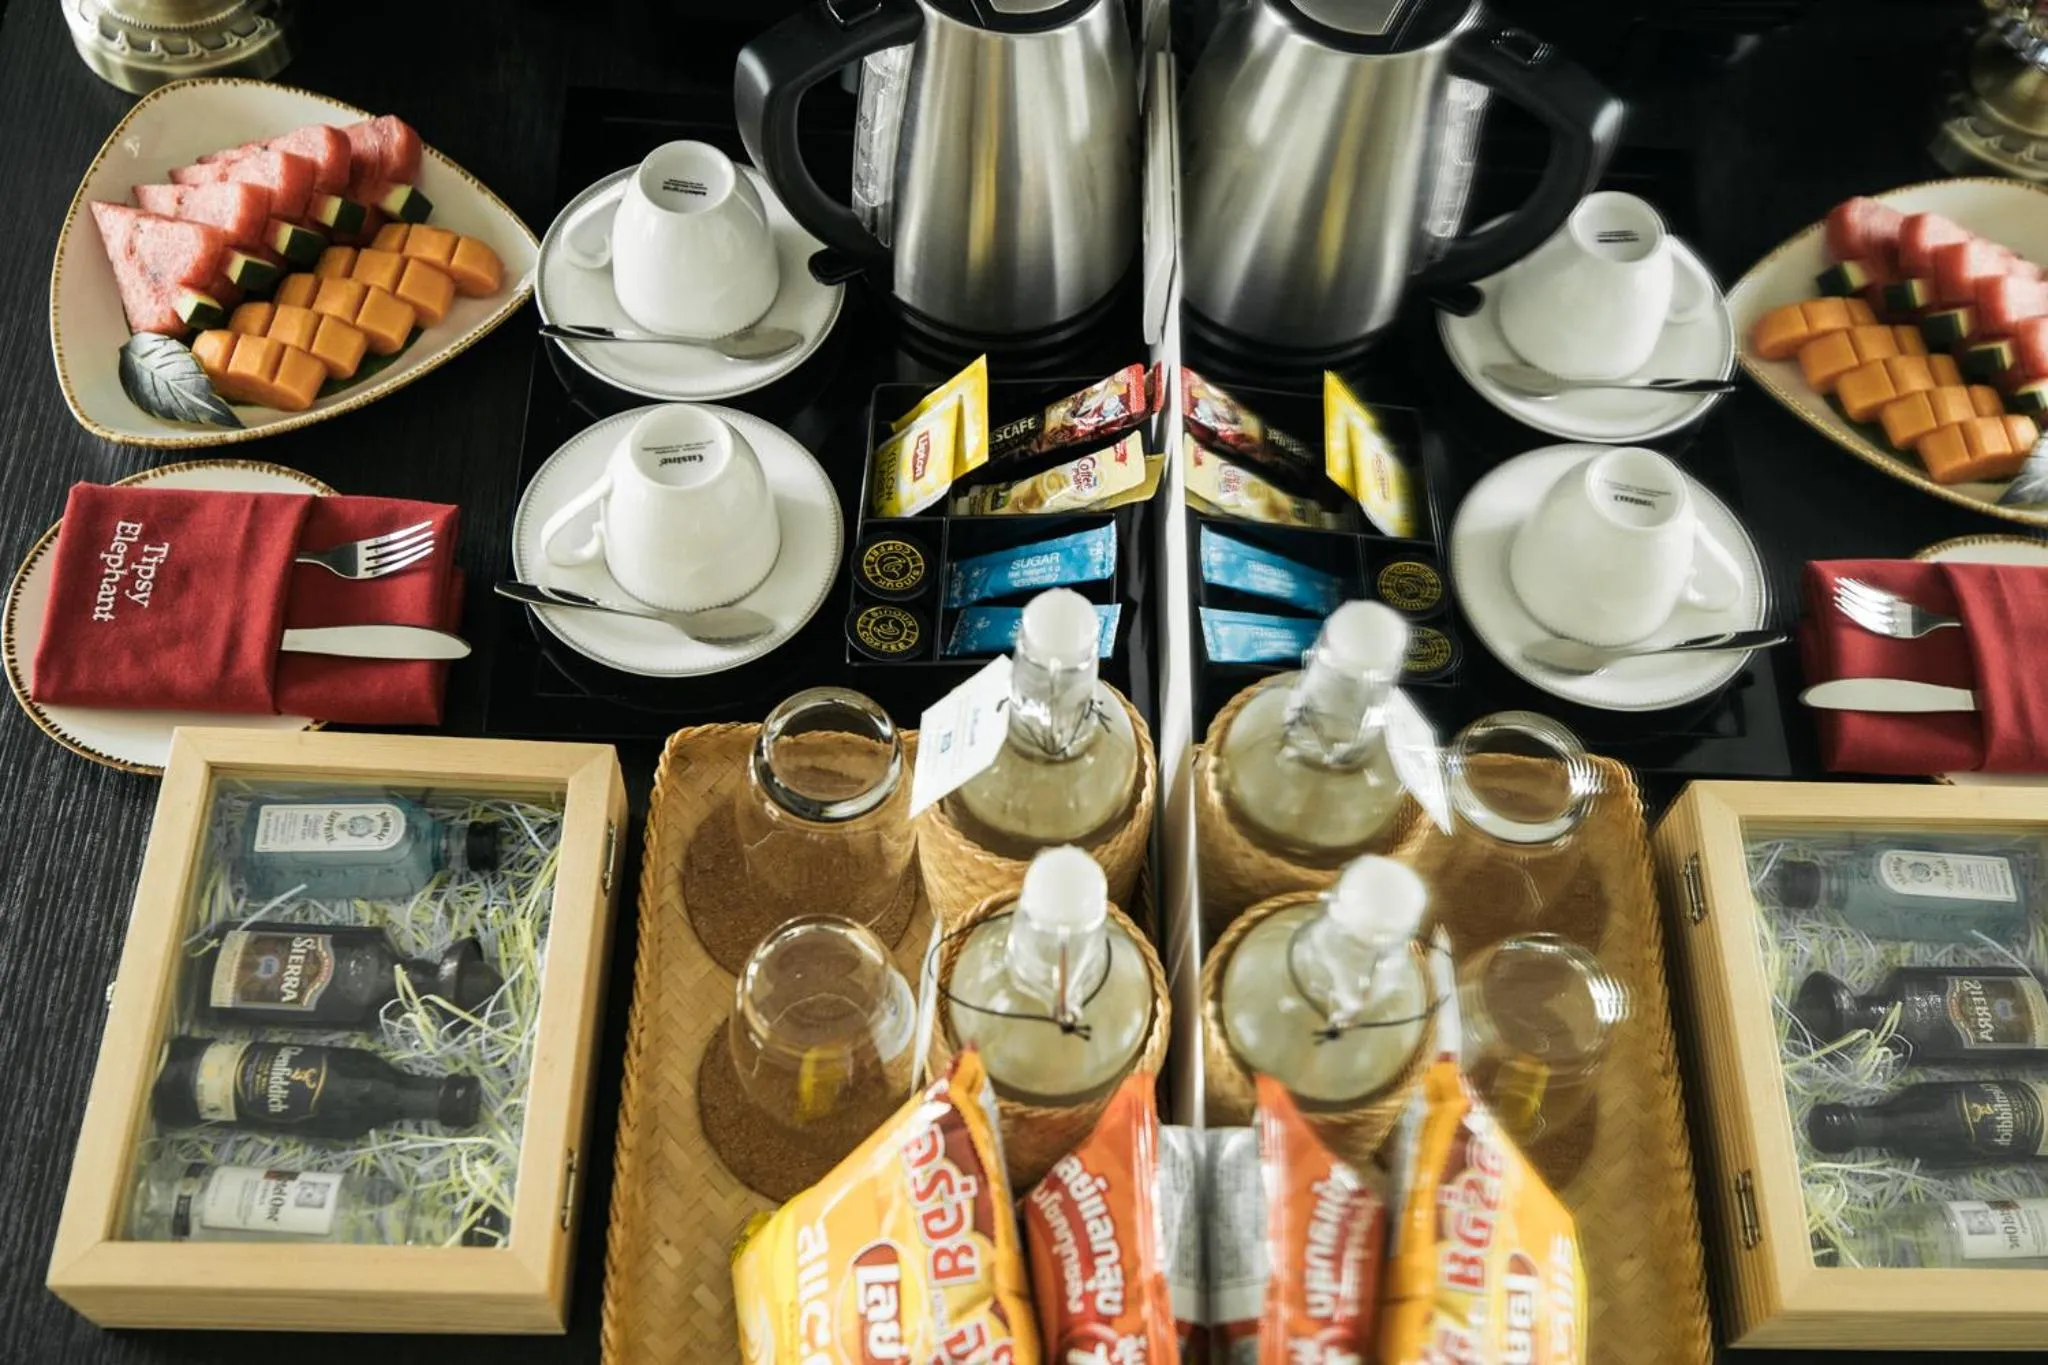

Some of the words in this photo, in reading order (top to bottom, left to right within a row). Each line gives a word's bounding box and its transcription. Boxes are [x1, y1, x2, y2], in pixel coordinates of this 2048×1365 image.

[91, 519, 144, 623] Elephant
[132, 542, 171, 609] Tipsy
[1010, 552, 1060, 570] SUGAR
[280, 937, 316, 1002] SIERRA
[901, 1122, 981, 1286] อร่อย
